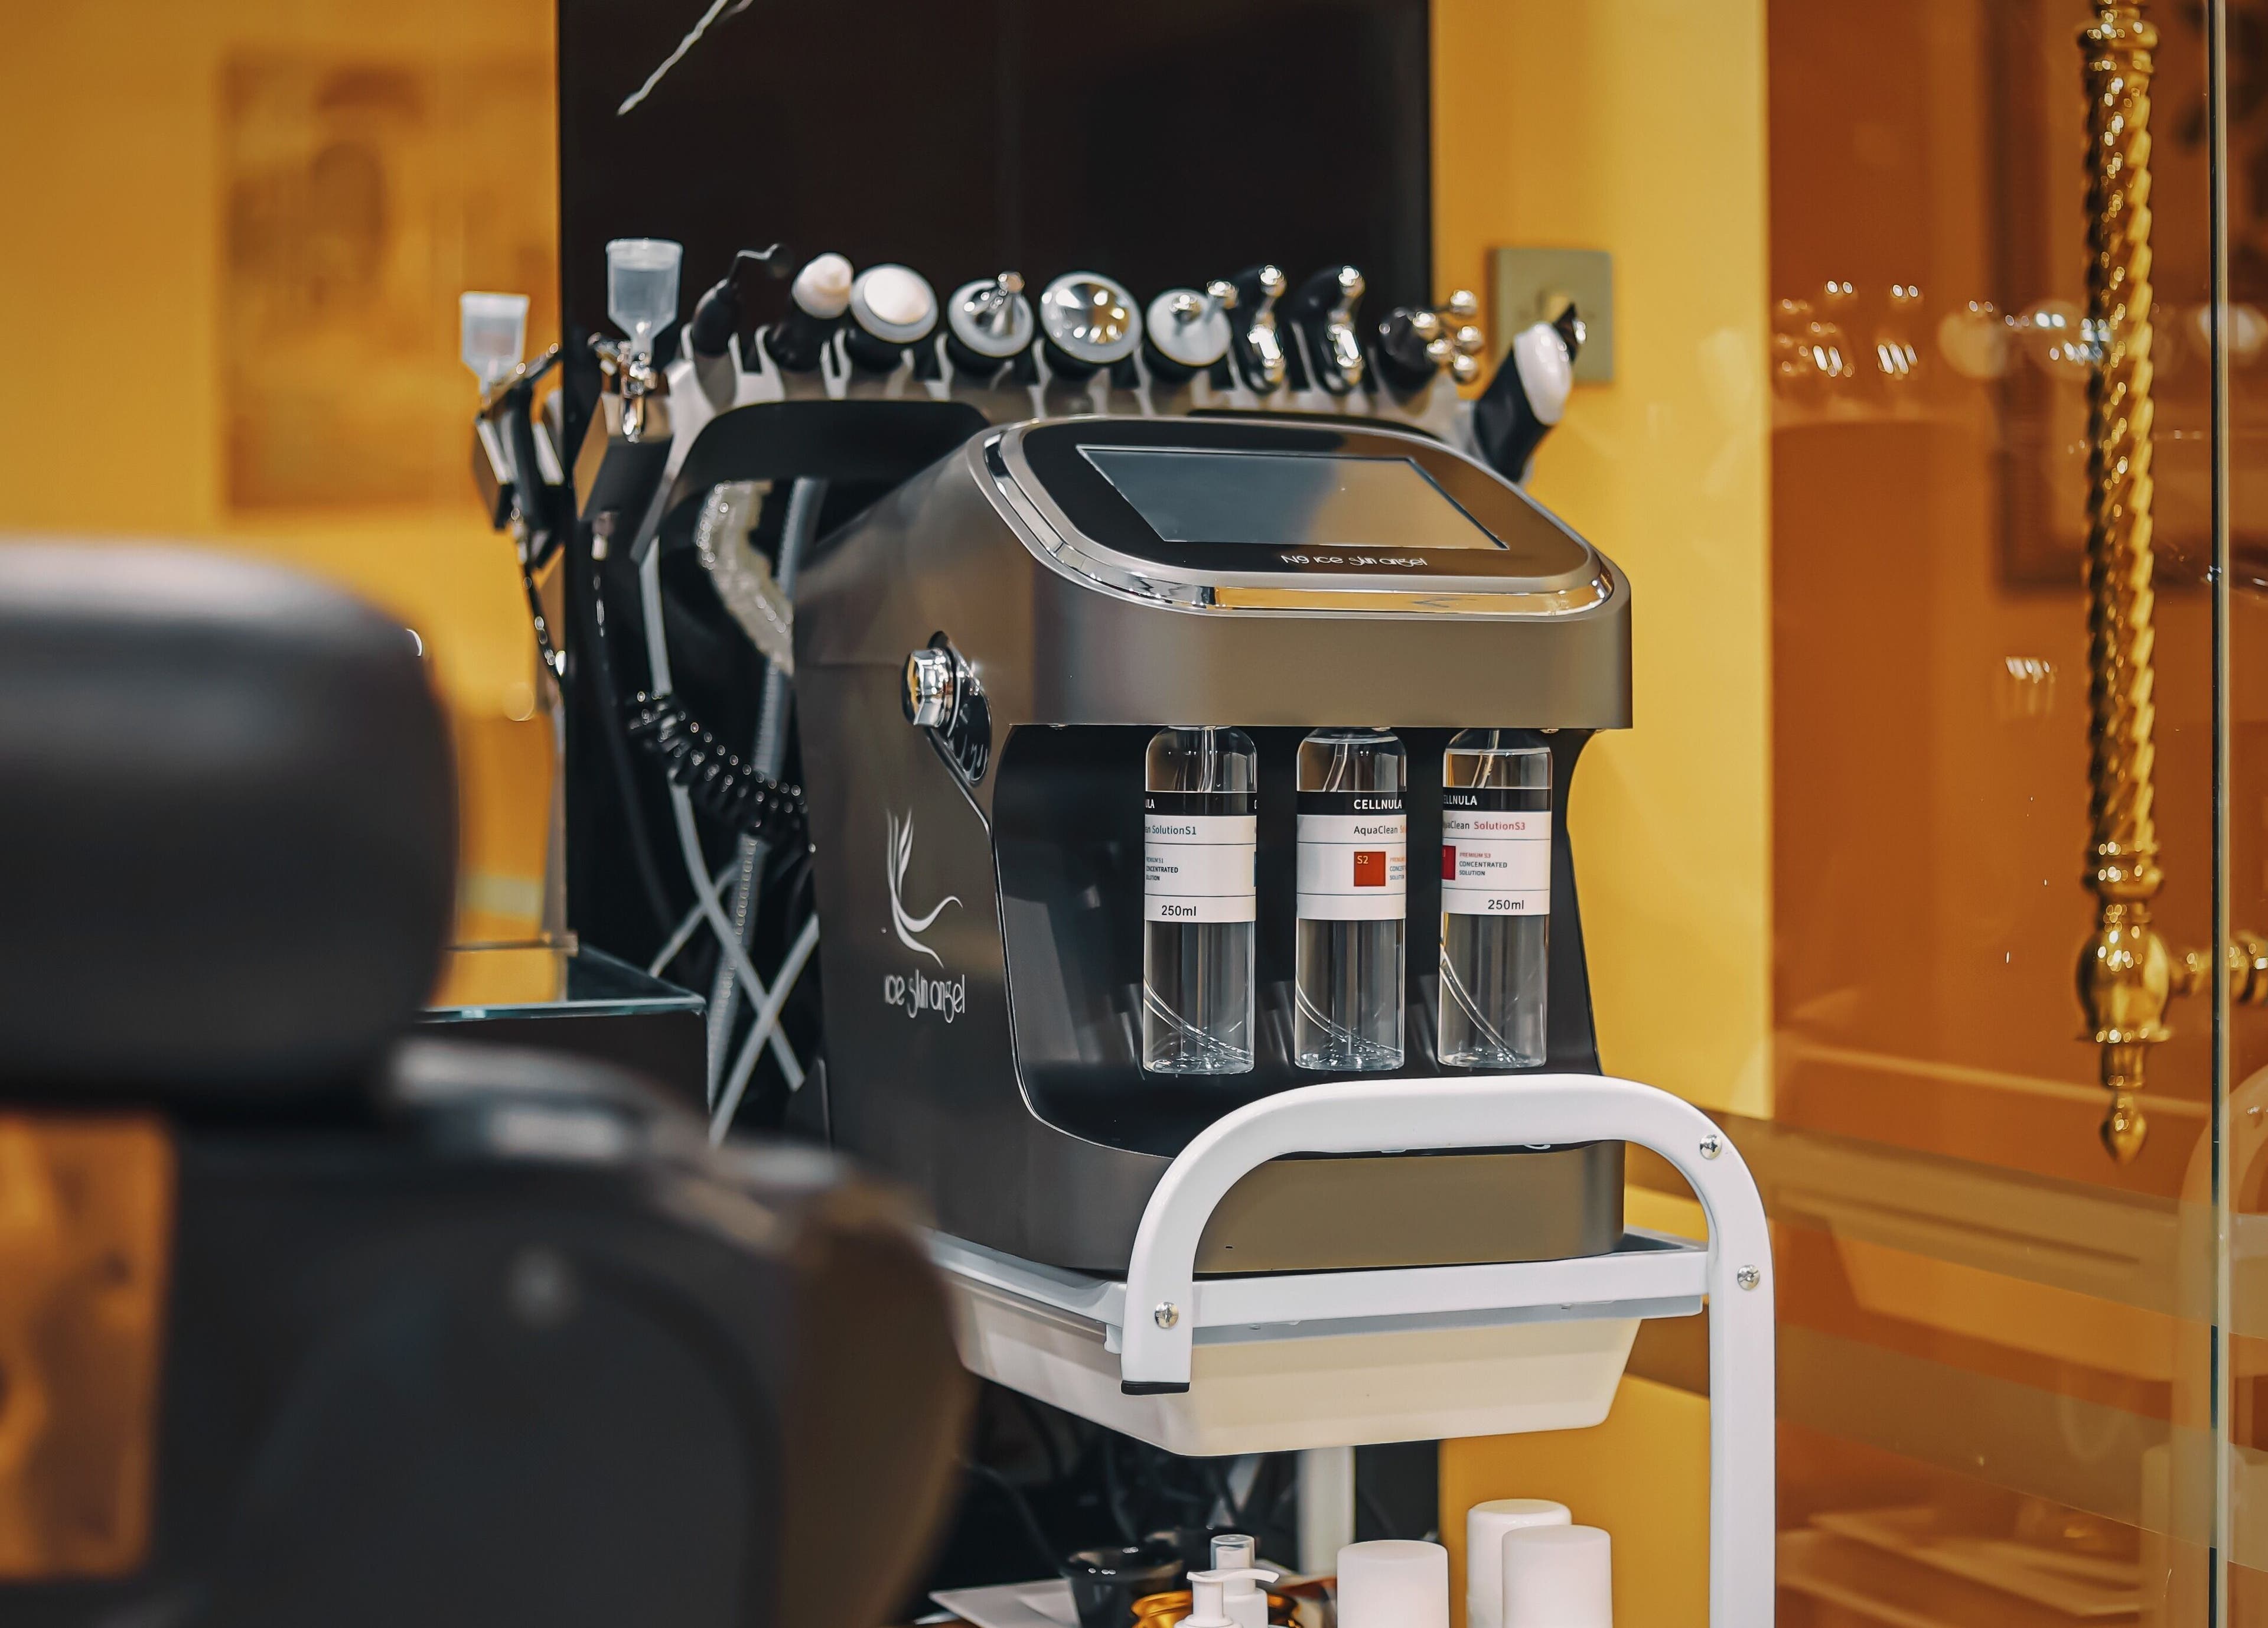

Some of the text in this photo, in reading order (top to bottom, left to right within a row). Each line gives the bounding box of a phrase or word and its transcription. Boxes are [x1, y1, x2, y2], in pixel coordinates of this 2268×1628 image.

[1280, 555, 1309, 564] N9
[1353, 799, 1402, 809] CELLNULA
[1443, 795, 1477, 806] ELLNULA
[1353, 825, 1398, 836] AquaClean
[1357, 855, 1369, 864] S2
[1488, 899, 1524, 910] 250ml
[1161, 905, 1197, 916] 250ml
